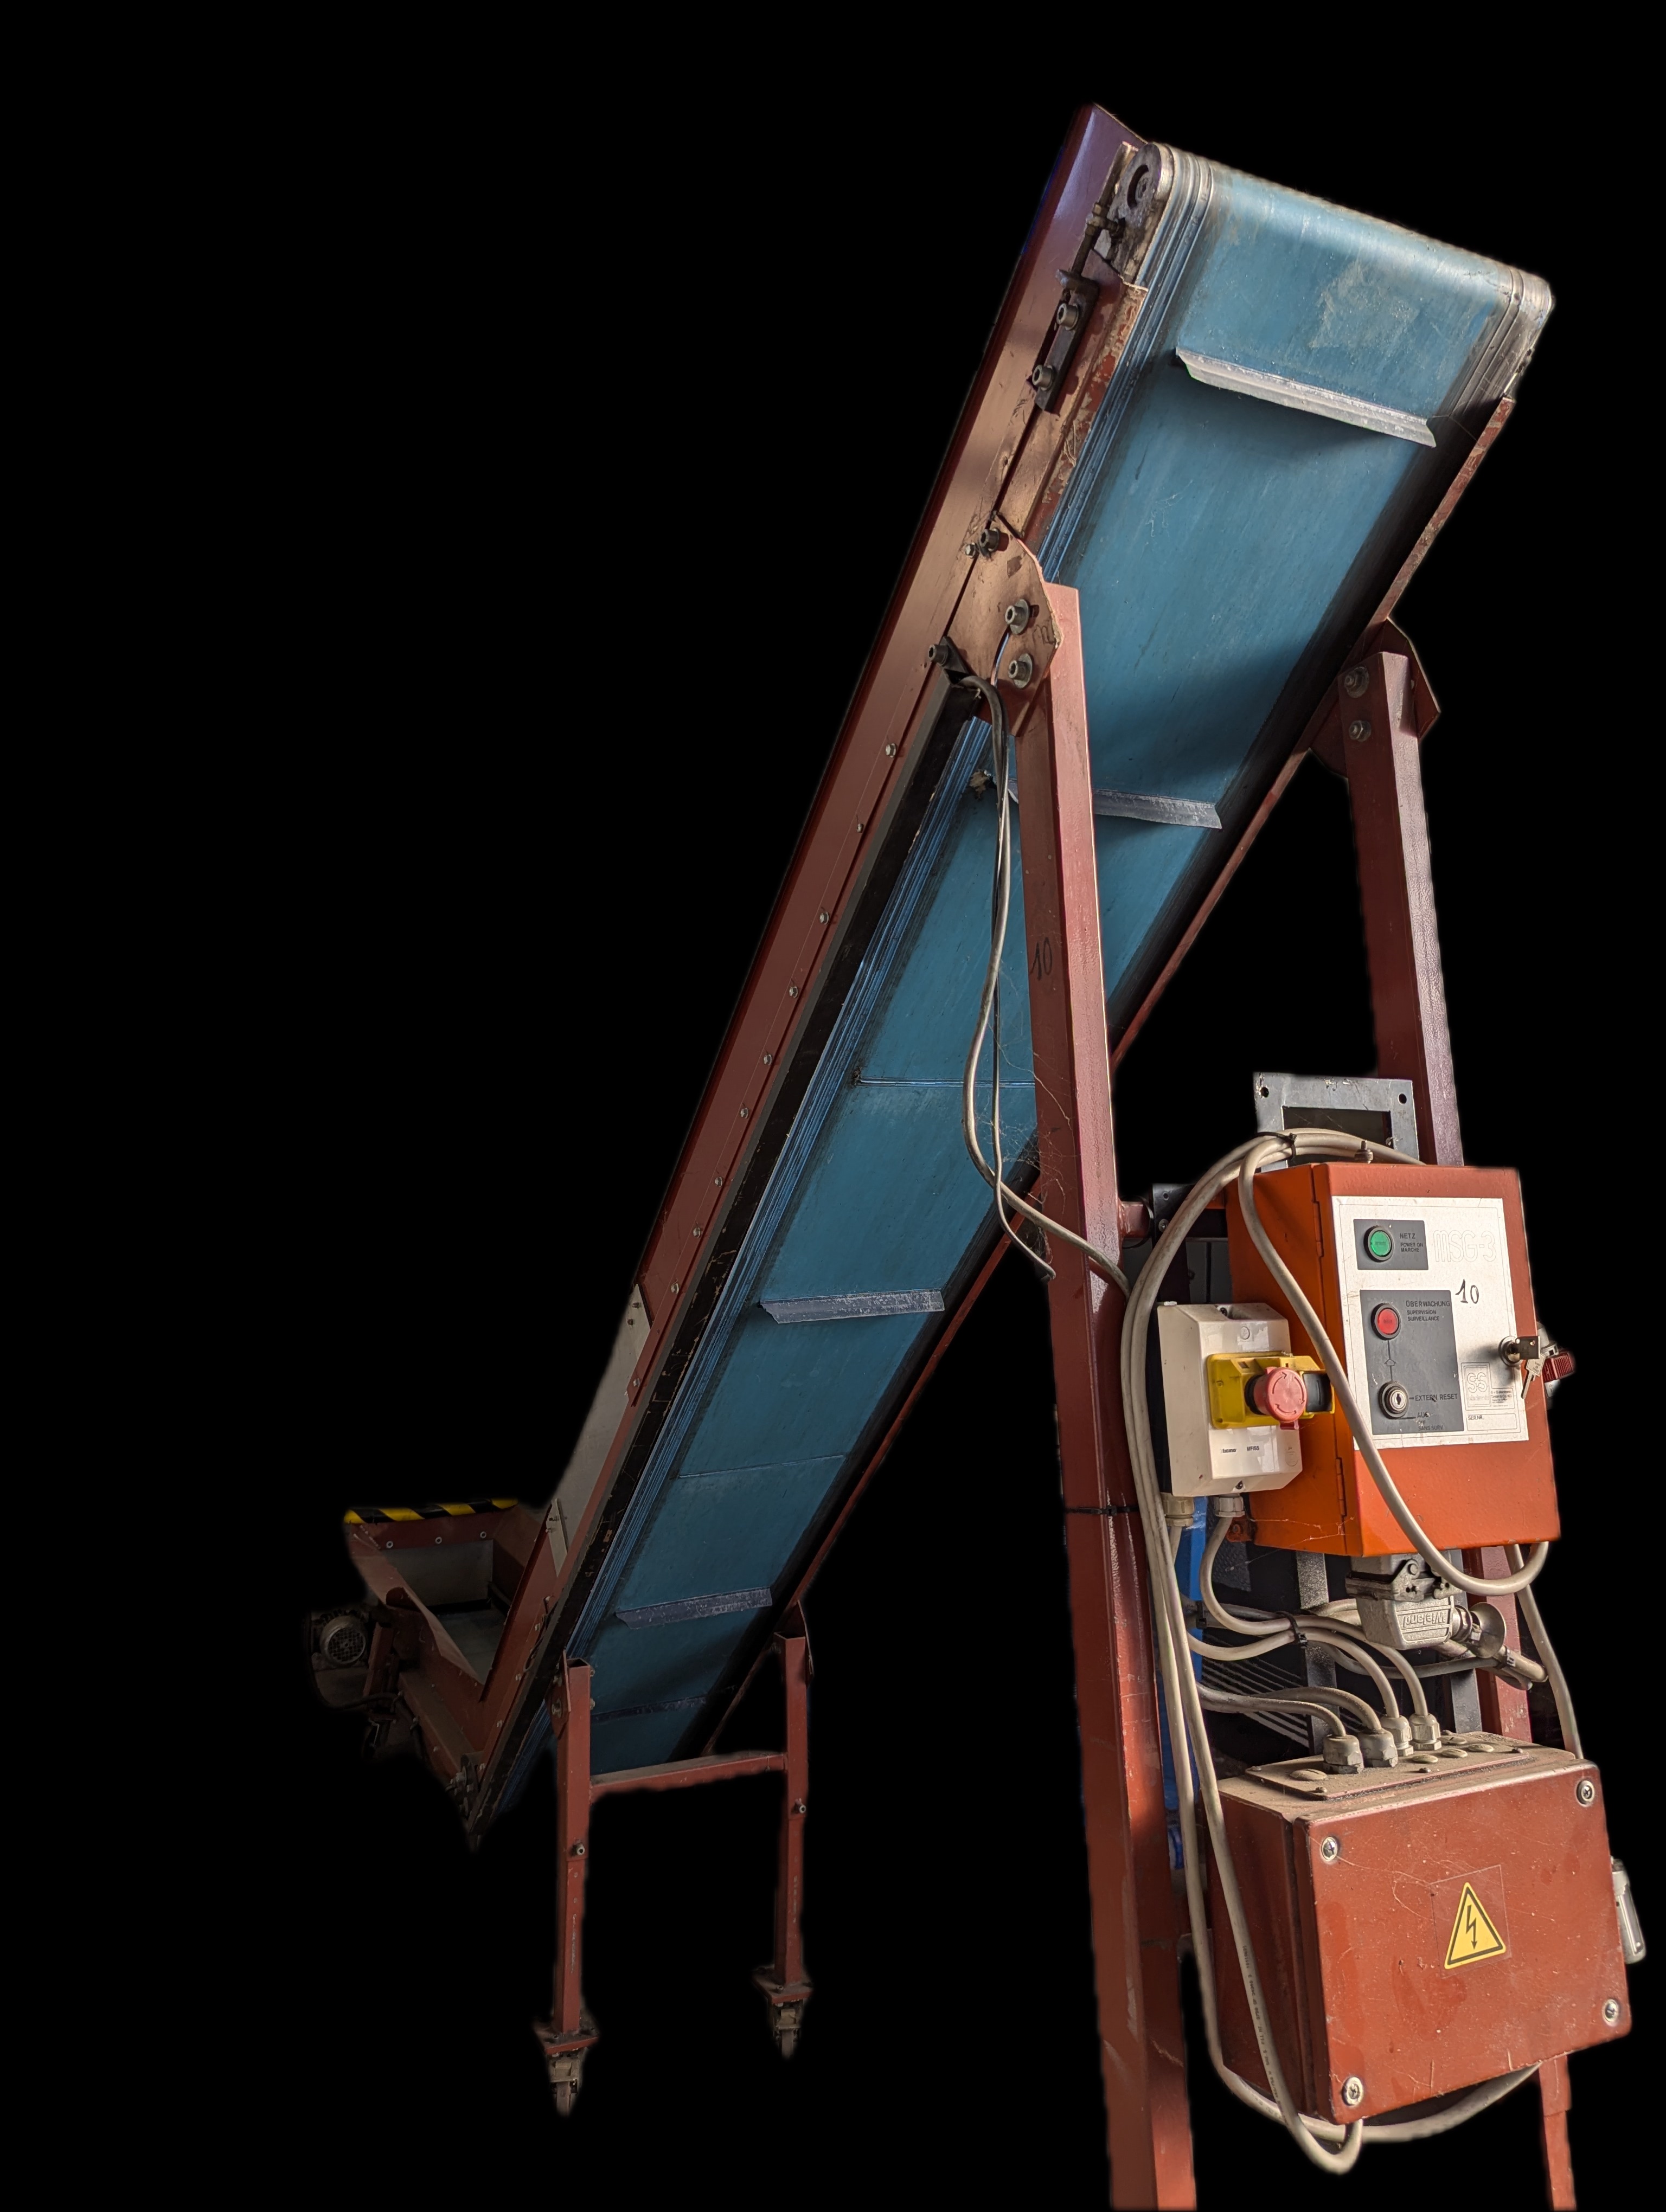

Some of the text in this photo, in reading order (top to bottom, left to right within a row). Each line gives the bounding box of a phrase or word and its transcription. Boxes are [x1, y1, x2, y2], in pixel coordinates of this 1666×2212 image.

[1030, 937, 1053, 981] 10
[1433, 1230, 1497, 1262] MSG-3
[1455, 1278, 1479, 1304] 10
[1403, 1611, 1446, 1628] Wieland
